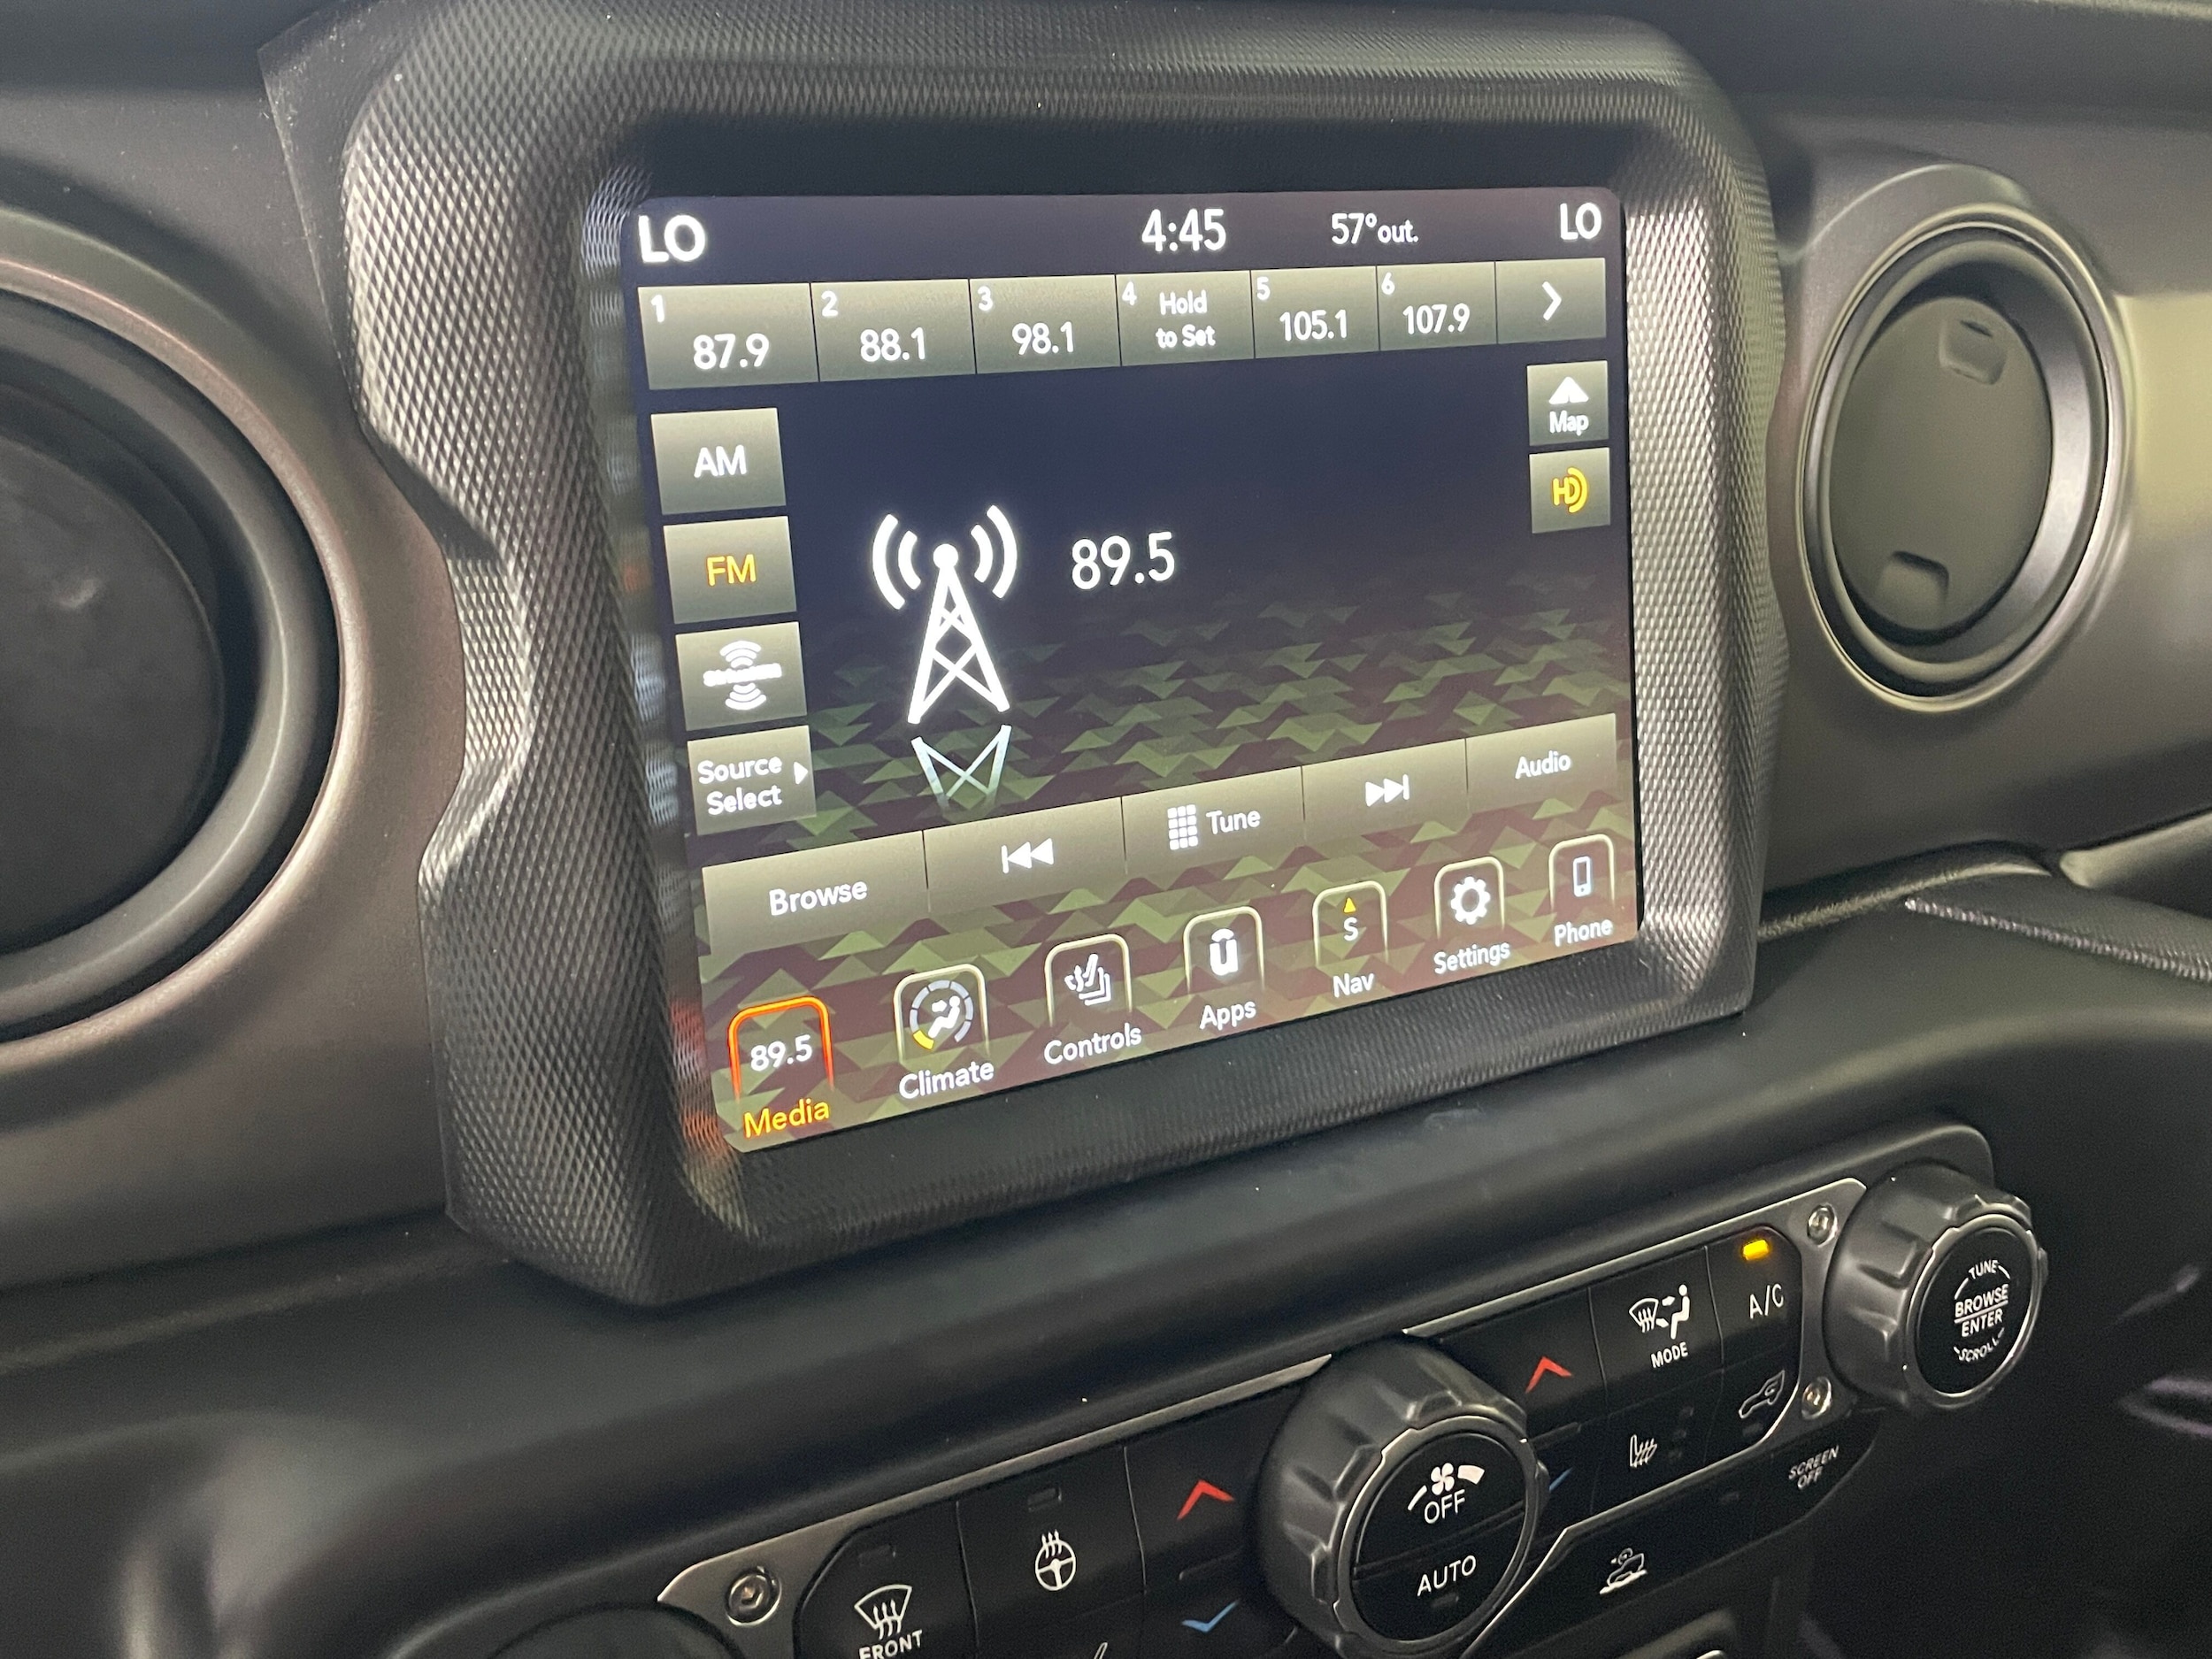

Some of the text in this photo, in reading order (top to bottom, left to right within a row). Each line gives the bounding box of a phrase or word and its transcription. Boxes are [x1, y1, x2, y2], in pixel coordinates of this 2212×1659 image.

[1141, 208, 1227, 252] 4:45
[1559, 203, 1602, 240] LO
[637, 214, 705, 263] LO
[978, 286, 994, 311] 3
[1122, 281, 1137, 305] 4
[1256, 277, 1271, 300] 5
[1381, 273, 1395, 295] 6
[650, 295, 665, 323] 1
[821, 291, 839, 317] 2
[1159, 290, 1208, 315] Hold
[1279, 310, 1348, 342] 105.1
[1402, 303, 1471, 334] 107.9
[693, 333, 769, 370] 87.9
[859, 326, 926, 362] 88.1
[1011, 321, 1074, 355] 98.1
[1156, 326, 1216, 348] to Set
[1548, 411, 1589, 435] Map
[694, 444, 747, 478] AM
[706, 554, 757, 586] FM
[1071, 531, 1176, 590] 89.5
[697, 756, 782, 786] Source
[1515, 750, 1571, 780] Audio
[707, 783, 782, 816] Select
[1206, 806, 1261, 836] Tune
[769, 880, 868, 917] Browse
[1344, 917, 1358, 941] S
[1554, 917, 1613, 947] Phone
[1433, 940, 1510, 975] Settings
[1333, 972, 1375, 999] Nav
[1199, 1000, 1256, 1030] Apps
[750, 1034, 813, 1072] 89.5
[1043, 1022, 1143, 1065] Controls
[898, 1060, 995, 1101] Climate
[743, 1097, 831, 1139] Media
[1969, 1259, 1999, 1279] TUNE
[1748, 1283, 1785, 1320] A/C
[1955, 1283, 2008, 1318] BROWSE
[1962, 1309, 2003, 1337] ENTER
[1651, 1341, 1688, 1369] MODE
[1959, 1337, 2000, 1362] SCROLL
[1788, 1445, 1839, 1479] SCREEN
[1797, 1465, 1824, 1490] OFF
[1424, 1490, 1466, 1525] OFF
[1417, 1555, 1477, 1596] AUTO
[858, 1629, 923, 1659] FRONT
